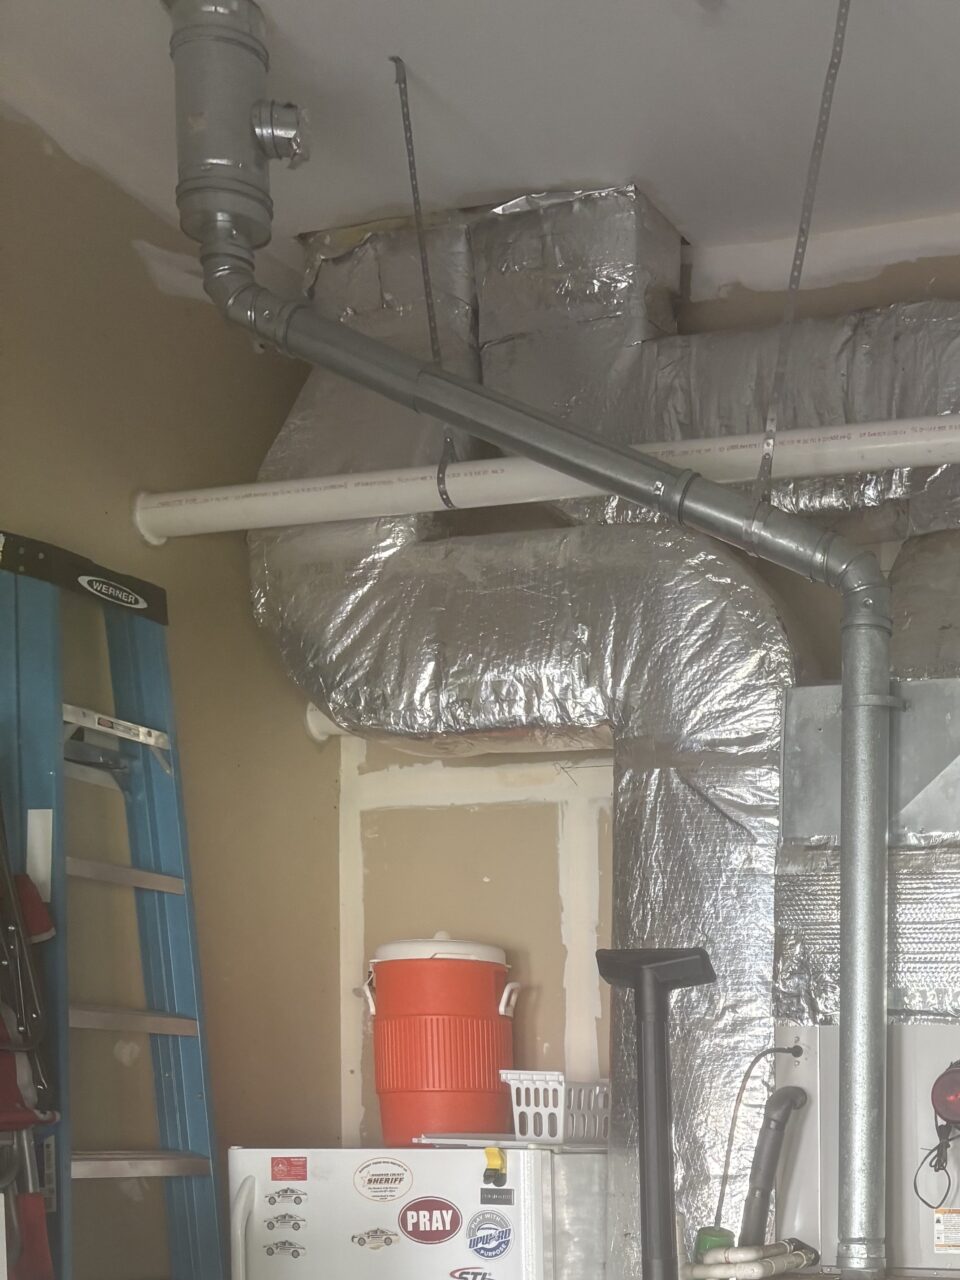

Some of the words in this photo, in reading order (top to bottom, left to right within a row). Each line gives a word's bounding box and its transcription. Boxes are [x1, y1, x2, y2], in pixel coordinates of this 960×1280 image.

[92, 580, 136, 604] WERNER
[406, 1210, 453, 1232] PRAY
[485, 1213, 501, 1222] WITH
